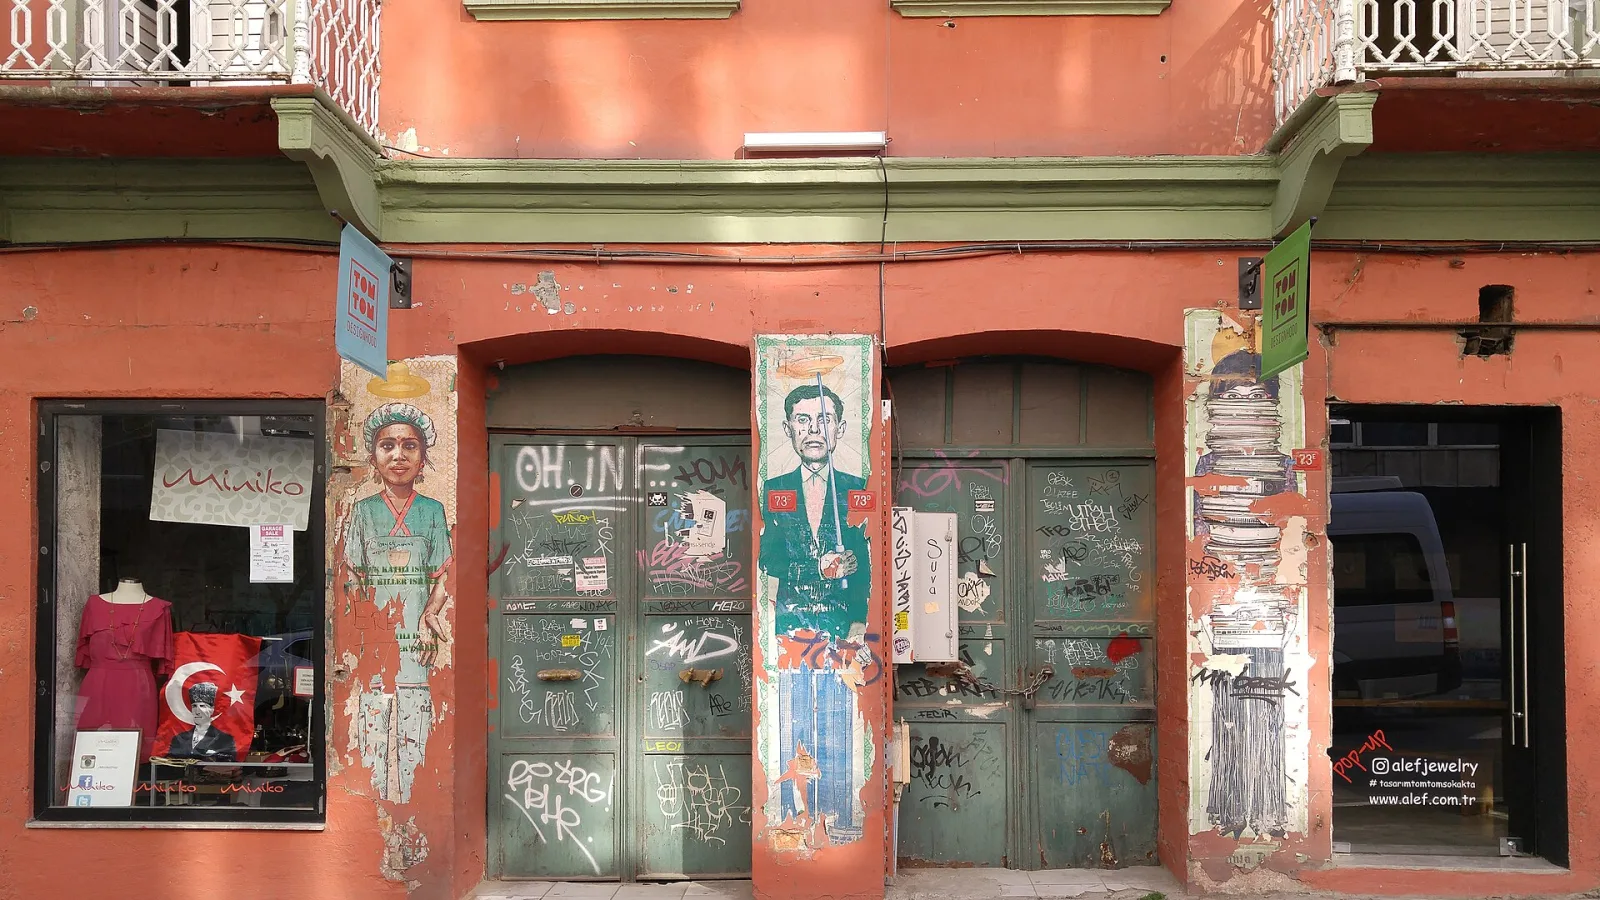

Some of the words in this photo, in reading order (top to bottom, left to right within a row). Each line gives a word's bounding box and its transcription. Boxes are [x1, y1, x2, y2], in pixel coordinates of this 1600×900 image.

[353, 270, 376, 300] TOM
[1275, 269, 1296, 298] TOM
[352, 293, 375, 321] TOM
[1274, 292, 1296, 320] TOM
[346, 321, 377, 348] DESIGNHOOD
[1270, 322, 1298, 349] DESIGNHOOD
[162, 467, 305, 497] Miniko
[645, 741, 682, 752] LEO!
[1391, 757, 1479, 776] alefjewelry
[133, 780, 197, 794] Miniko
[220, 780, 284, 794] Miniko
[1369, 792, 1476, 806] www.alef.com.tr
